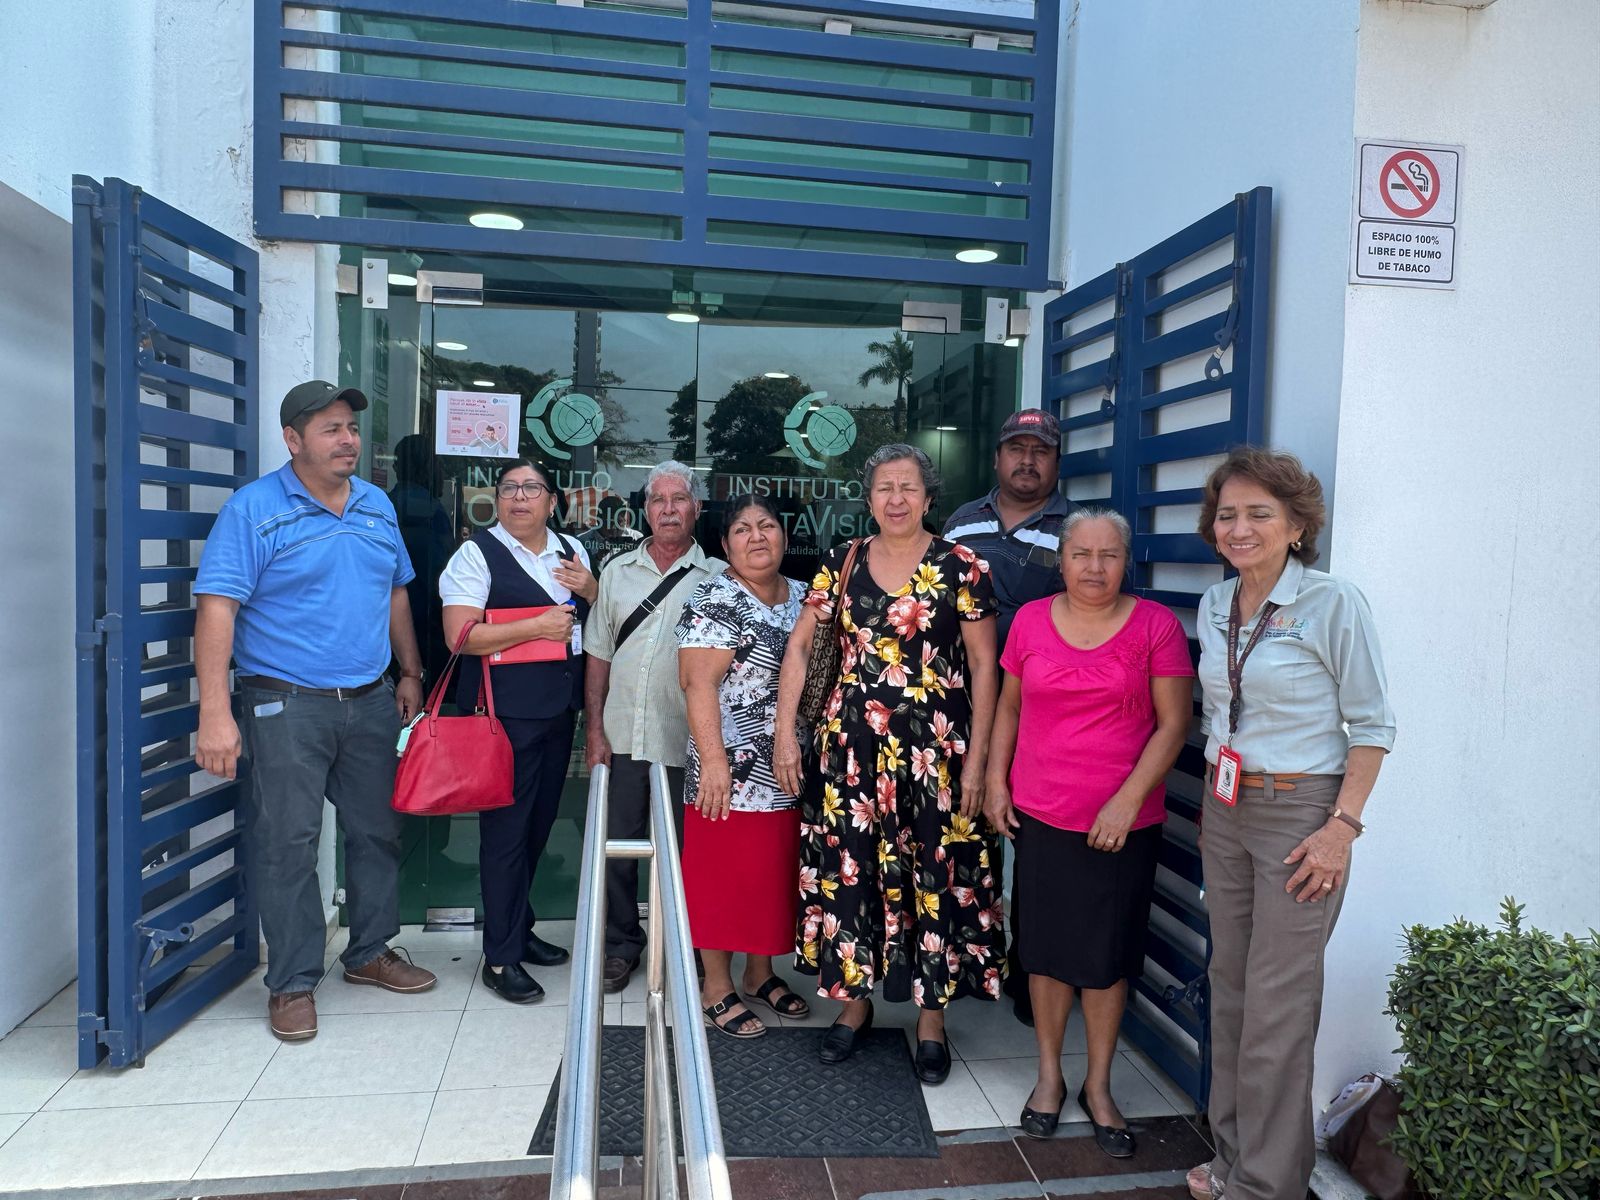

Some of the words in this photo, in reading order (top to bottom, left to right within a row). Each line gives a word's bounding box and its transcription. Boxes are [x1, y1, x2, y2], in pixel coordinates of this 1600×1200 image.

[1372, 232, 1412, 243] ESPACIO
[1415, 235, 1440, 245] 100%
[1368, 246, 1396, 256] LIBRE
[1398, 249, 1411, 257] DE
[1413, 249, 1442, 259] HUMO
[1378, 262, 1391, 271] DE
[1393, 263, 1431, 273] TABACO
[467, 465, 612, 492] INUTO
[729, 475, 863, 500] INSTITUTO
